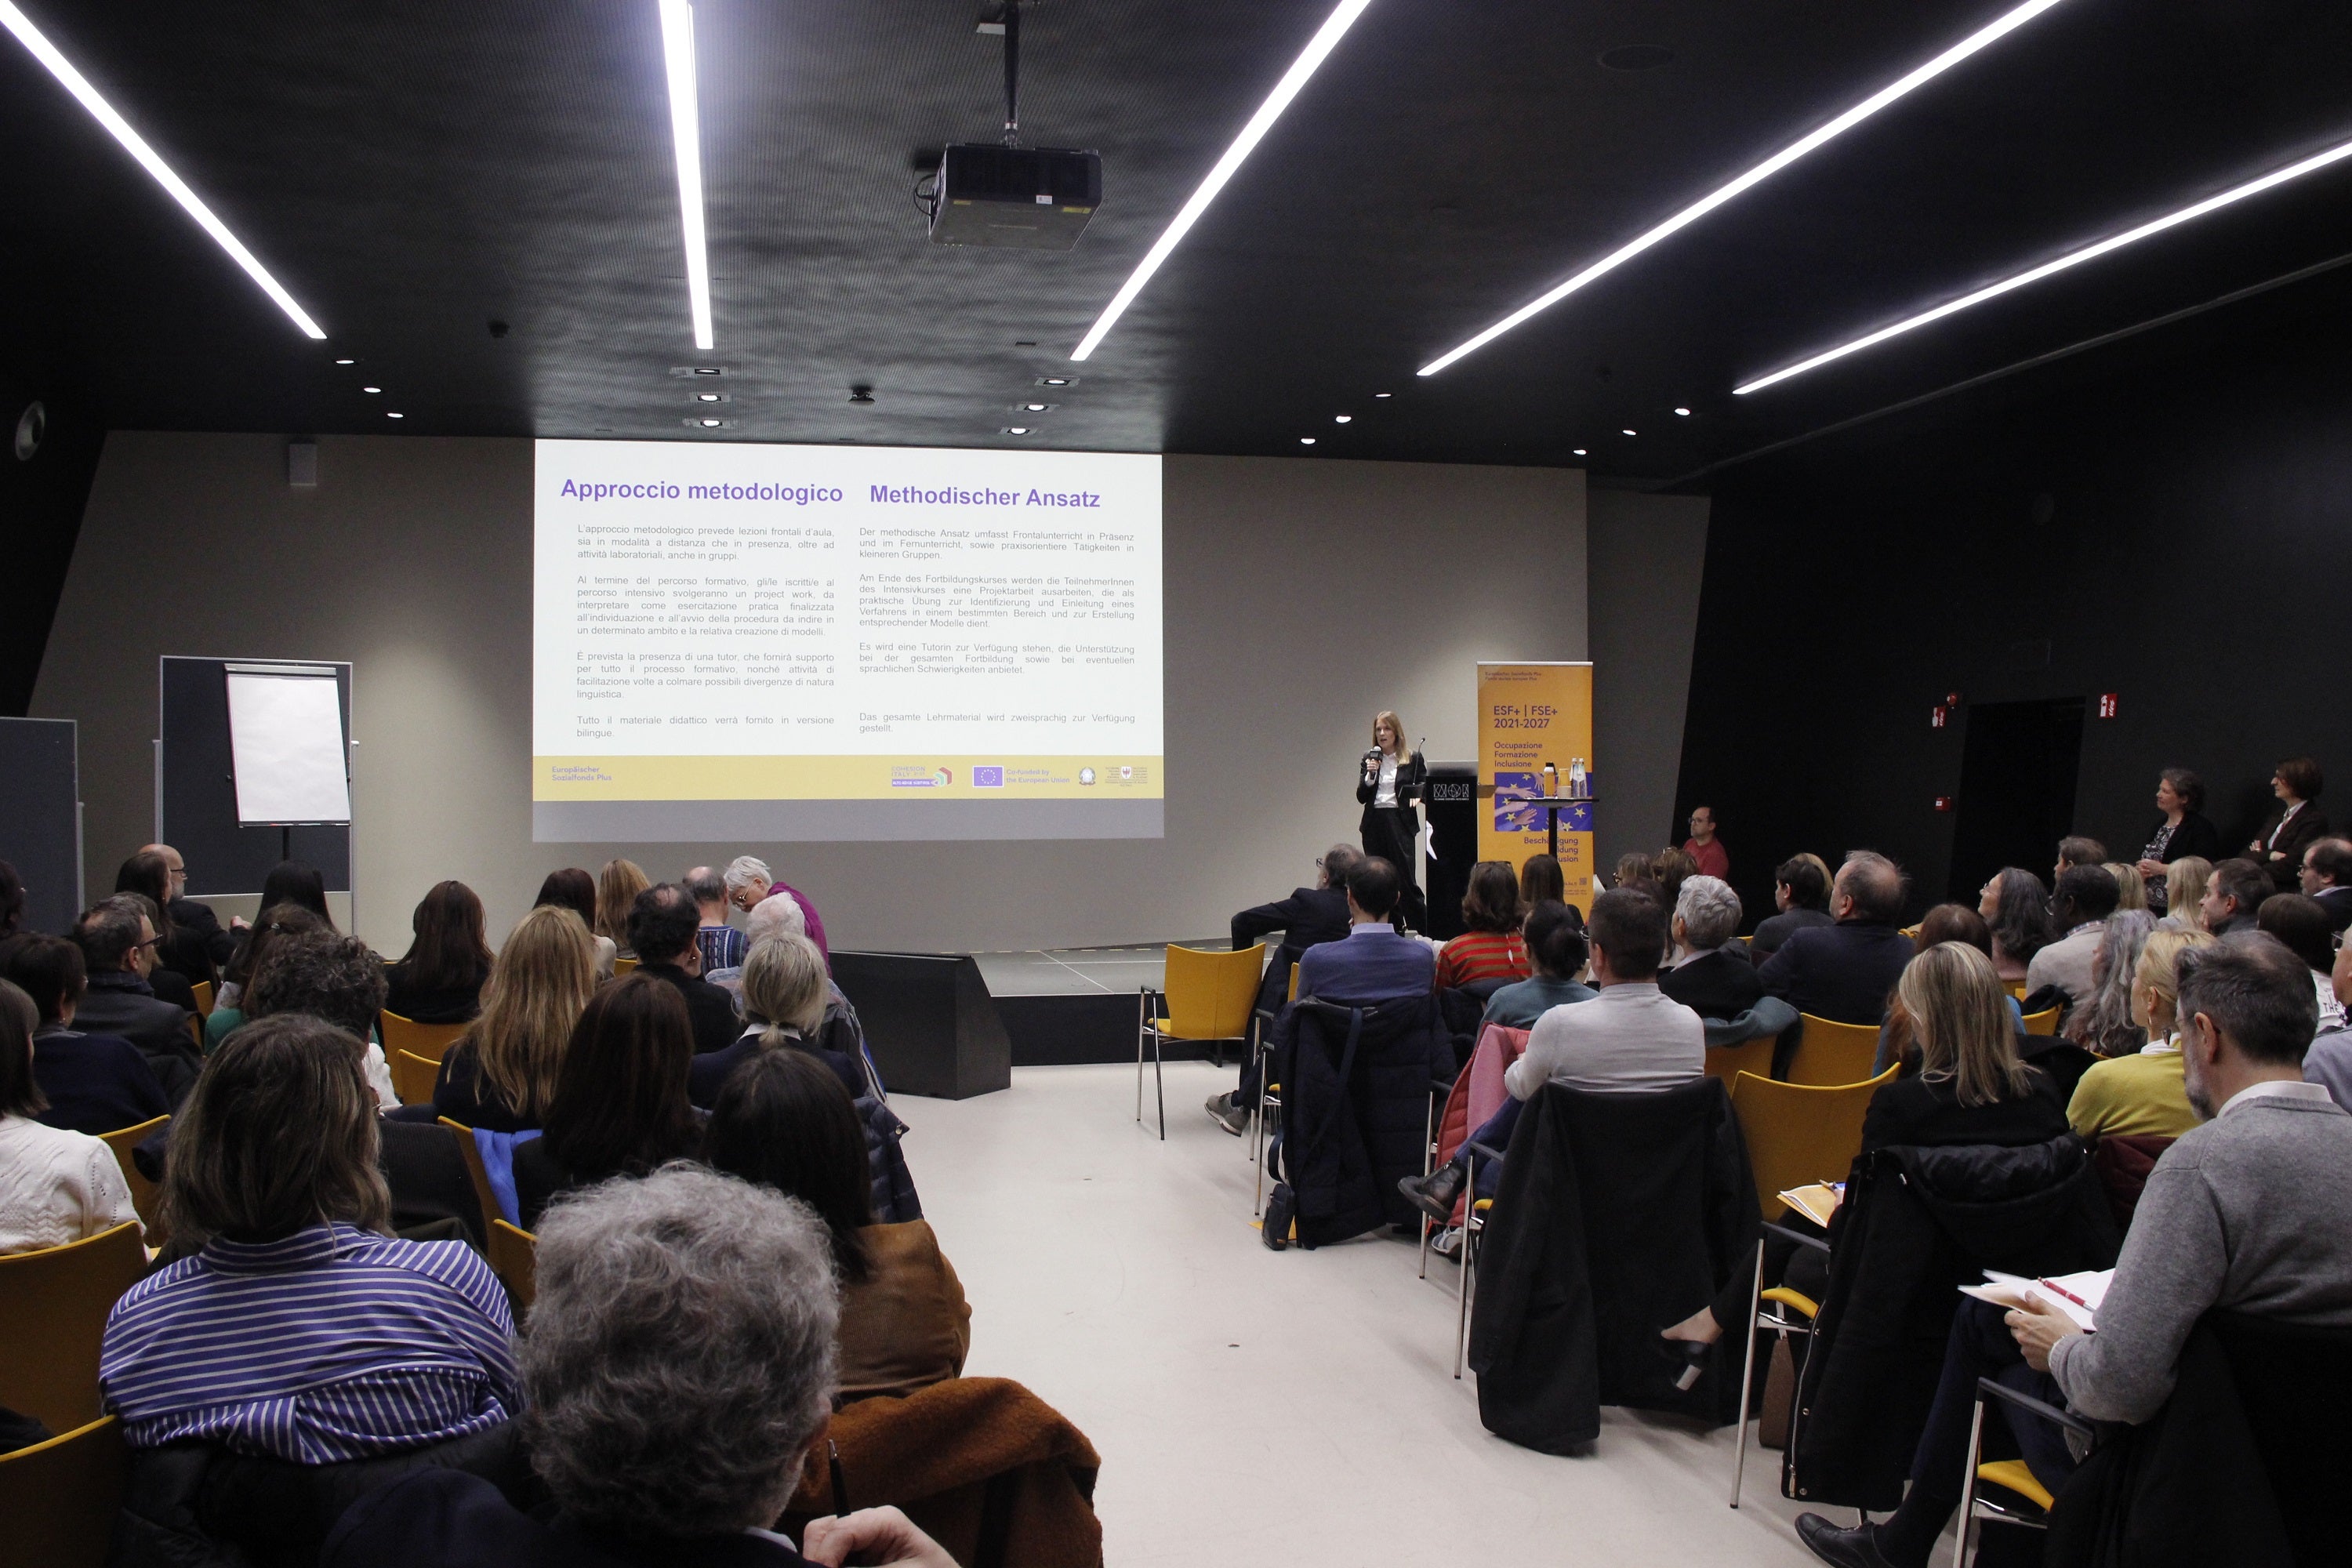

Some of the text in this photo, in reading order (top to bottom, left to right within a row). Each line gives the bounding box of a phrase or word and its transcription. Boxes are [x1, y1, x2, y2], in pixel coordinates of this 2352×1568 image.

[561, 479, 843, 506] Approccio metodologico
[871, 485, 1101, 507] Methodischer Ansatz
[634, 525, 694, 535] metodologico
[698, 526, 735, 536] prevede
[739, 527, 767, 535] lezioni
[771, 527, 801, 535] frontali
[940, 529, 969, 538] Ansatz
[974, 530, 1007, 539] umfasst
[1012, 531, 1083, 539] Frontalunterricht
[1100, 532, 1135, 541] Präsenz
[579, 537, 818, 550] sia modalità distanza che presenza, oltre
[900, 539, 962, 549] Fernunterricht,
[578, 550, 607, 558] attività
[610, 550, 665, 560] laboratoriali,
[709, 551, 739, 562] gruppi.
[859, 550, 942, 561] kleineren Gruppen.
[595, 575, 629, 584] termine
[658, 578, 697, 586] percorso
[705, 577, 749, 586] formativo,
[879, 574, 901, 583] Ende
[926, 575, 1007, 585] Fortbildungskurses
[1065, 577, 1135, 586] TeilnehmerInnen
[578, 588, 816, 600] percorso intensivo svolgeranno project work,
[979, 586, 1033, 597] Projektarbeit
[1041, 588, 1094, 597] ausarbeiten,
[578, 601, 630, 611] interpretare
[677, 601, 737, 610] esercitazione
[748, 602, 779, 612] pratica
[790, 602, 835, 611] finalizzata
[860, 595, 1135, 609] praktische Übung Identifizierung Einleitung eines
[708, 614, 730, 622] della
[733, 615, 779, 625] procedura
[798, 615, 823, 623] indire
[958, 608, 1007, 617] bestimmten
[1014, 609, 1046, 618] Bereich
[1093, 611, 1135, 620] Erstellung
[859, 618, 927, 628] entsprechender
[930, 619, 964, 627] Modelle
[591, 626, 826, 636] determinato ambito relativa creazione modelli.
[921, 643, 951, 652] Tutorin
[974, 644, 1018, 654] Verfügung
[1022, 644, 1053, 653] stehen,
[1076, 644, 1134, 655] Unterstützung
[588, 652, 624, 662] prevista
[639, 654, 681, 662] presenza
[717, 652, 739, 662] tutor,
[744, 652, 760, 661] che
[764, 652, 793, 661] fornirà
[797, 653, 836, 663] supporto
[910, 654, 953, 664] gesamten
[965, 655, 1014, 665] Fortbildung
[1086, 655, 1136, 664] eventuellen
[577, 666, 592, 674] per
[601, 664, 620, 673] tutto
[644, 666, 684, 675] processo
[694, 665, 737, 674] formativo,
[789, 665, 818, 673] attività
[860, 664, 914, 674] sprachlichen
[917, 665, 985, 675] Schwierigkeiten
[578, 677, 630, 685] facilitazione
[666, 677, 702, 686] colmare
[705, 677, 741, 688] possibili
[744, 677, 793, 688] divergenze
[807, 677, 835, 686] natura
[577, 690, 624, 700] linguistica.
[1494, 706, 1520, 715] ESF+
[1531, 706, 1558, 716] FSE+
[577, 716, 835, 724] Tutto materiale didattico verrà fornito versione
[884, 713, 920, 723] gesamte
[1011, 713, 1066, 724] zweisprachig
[1092, 714, 1135, 724] Verfügung
[1494, 718, 1550, 728] 2021-2027
[577, 728, 615, 739] bilingue.
[859, 724, 893, 734] gestellt.
[1494, 741, 1543, 750] Occupazione
[1523, 837, 1578, 845] Beschäigung
